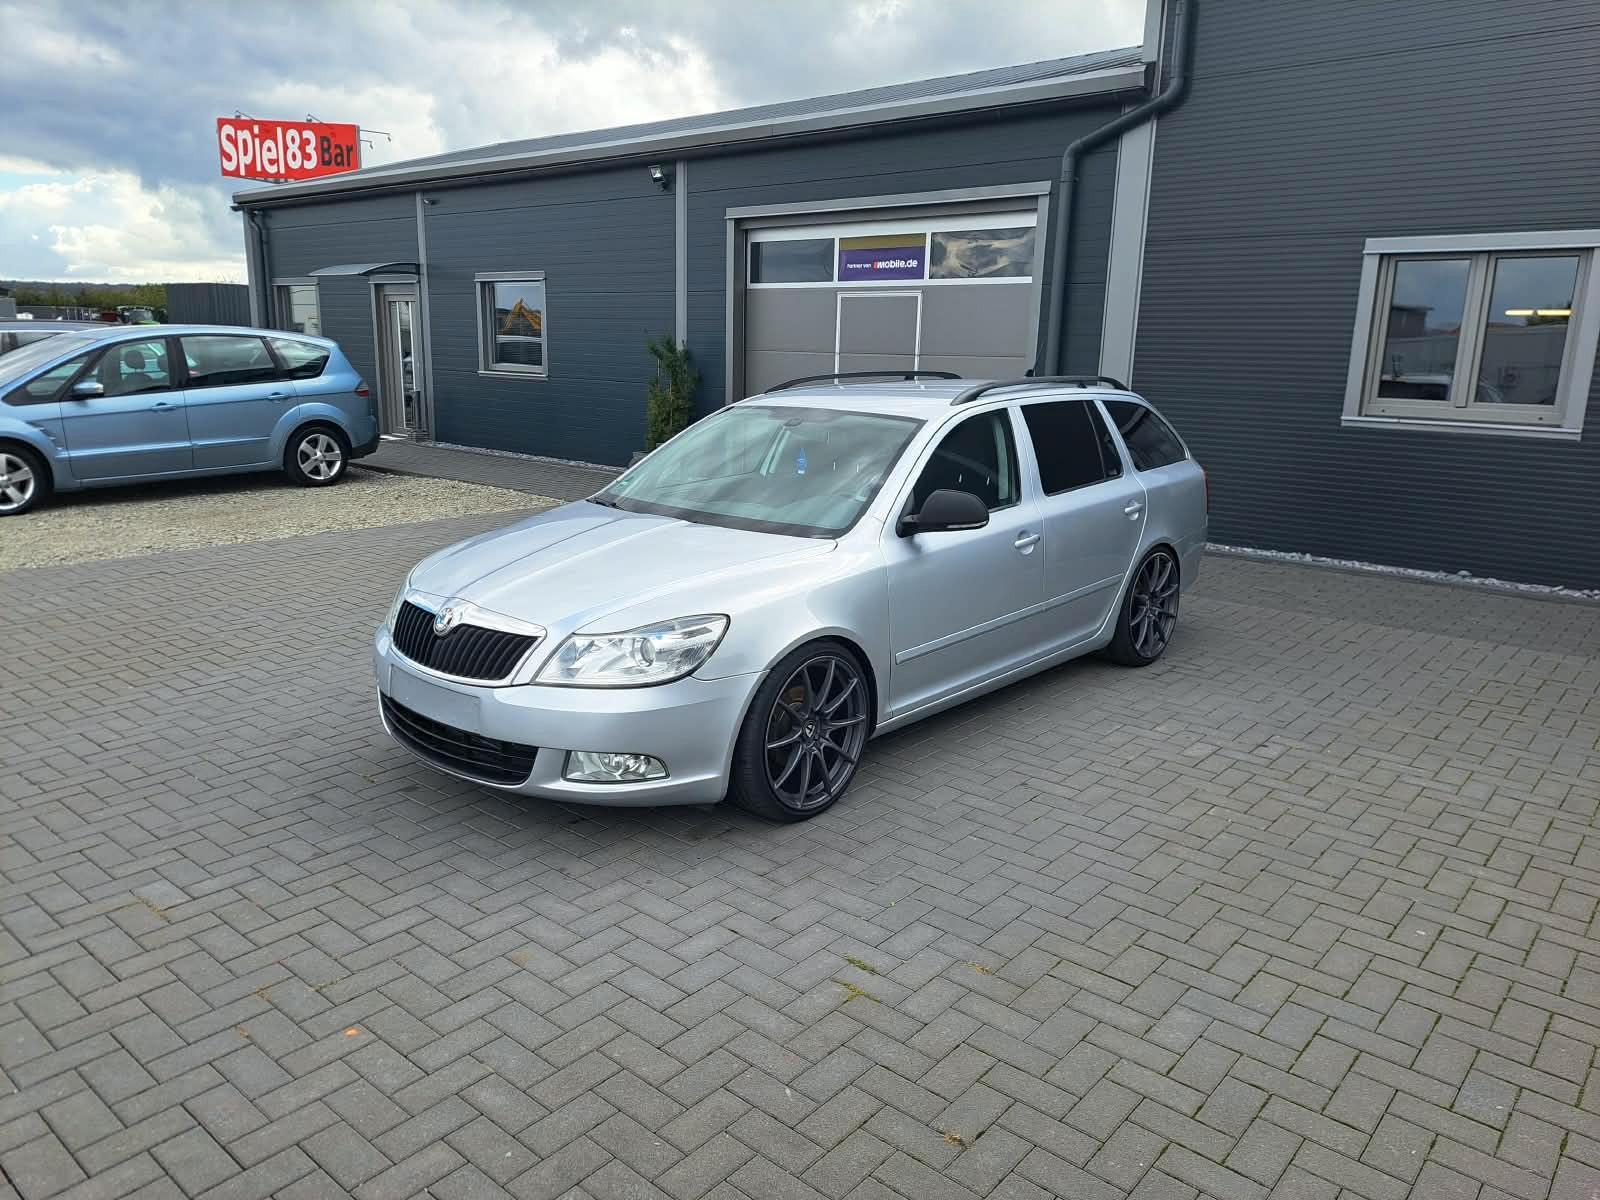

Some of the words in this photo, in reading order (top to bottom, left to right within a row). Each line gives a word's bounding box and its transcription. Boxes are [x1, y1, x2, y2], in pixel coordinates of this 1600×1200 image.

[220, 124, 318, 176] Spiel83
[320, 135, 353, 167] Bar
[877, 258, 918, 269] mobile.de
